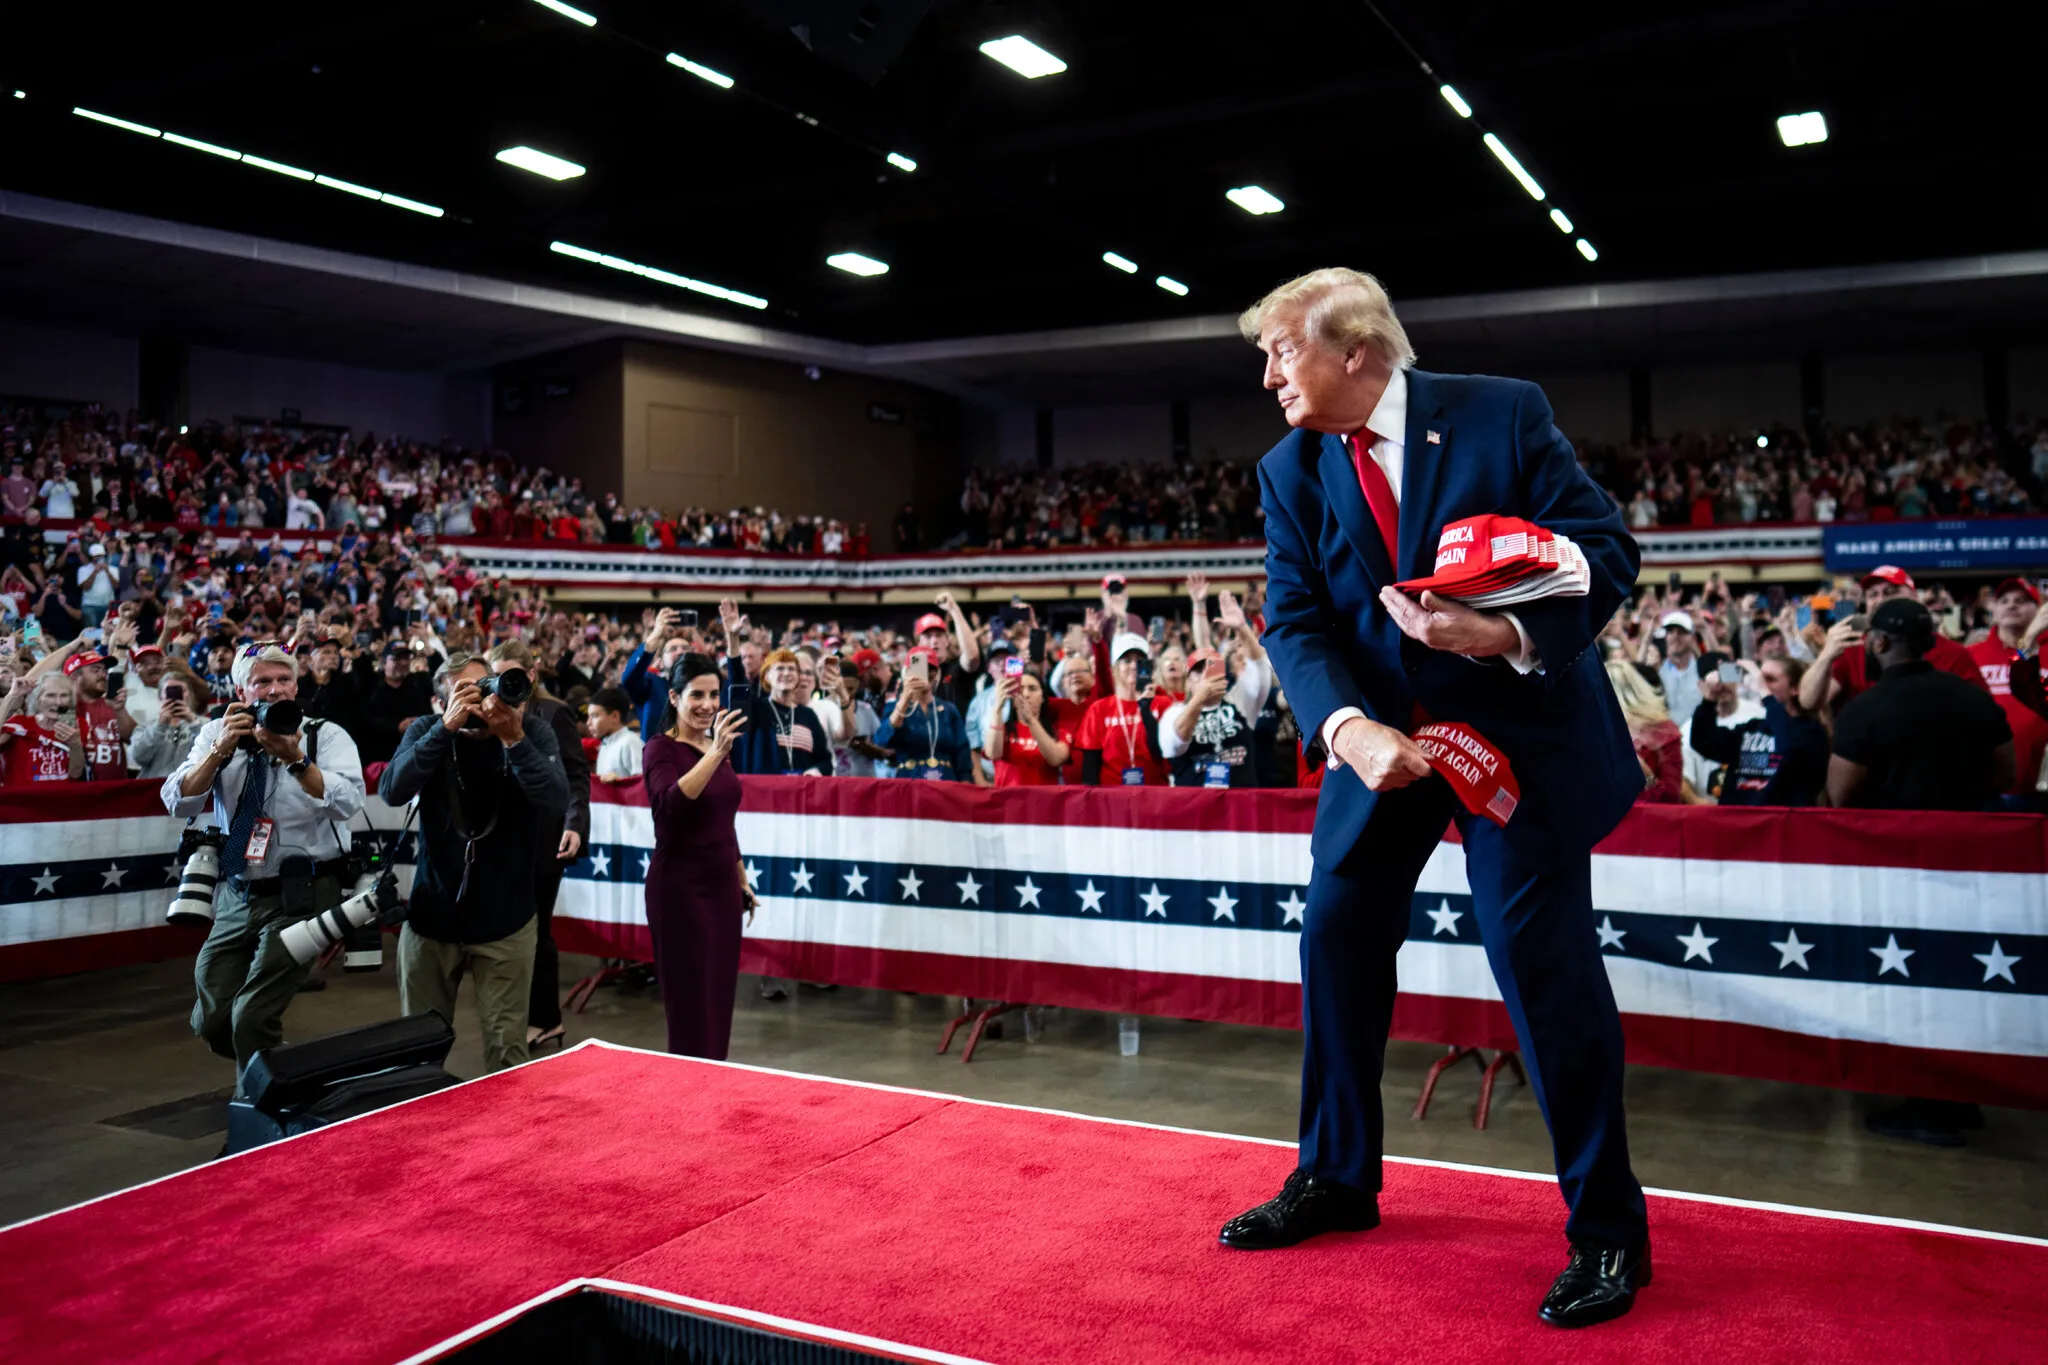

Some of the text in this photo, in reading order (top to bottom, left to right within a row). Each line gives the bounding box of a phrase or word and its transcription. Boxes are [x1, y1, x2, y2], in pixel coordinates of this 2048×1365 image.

[1437, 525, 1474, 551] MERICA
[1836, 541, 1880, 554] MAKE
[1885, 538, 1954, 553] AMERICA
[1958, 536, 2010, 550] GREAT
[1415, 725, 1499, 777] MAKE AMERICA
[1416, 739, 1483, 787] REAT AGAIN
